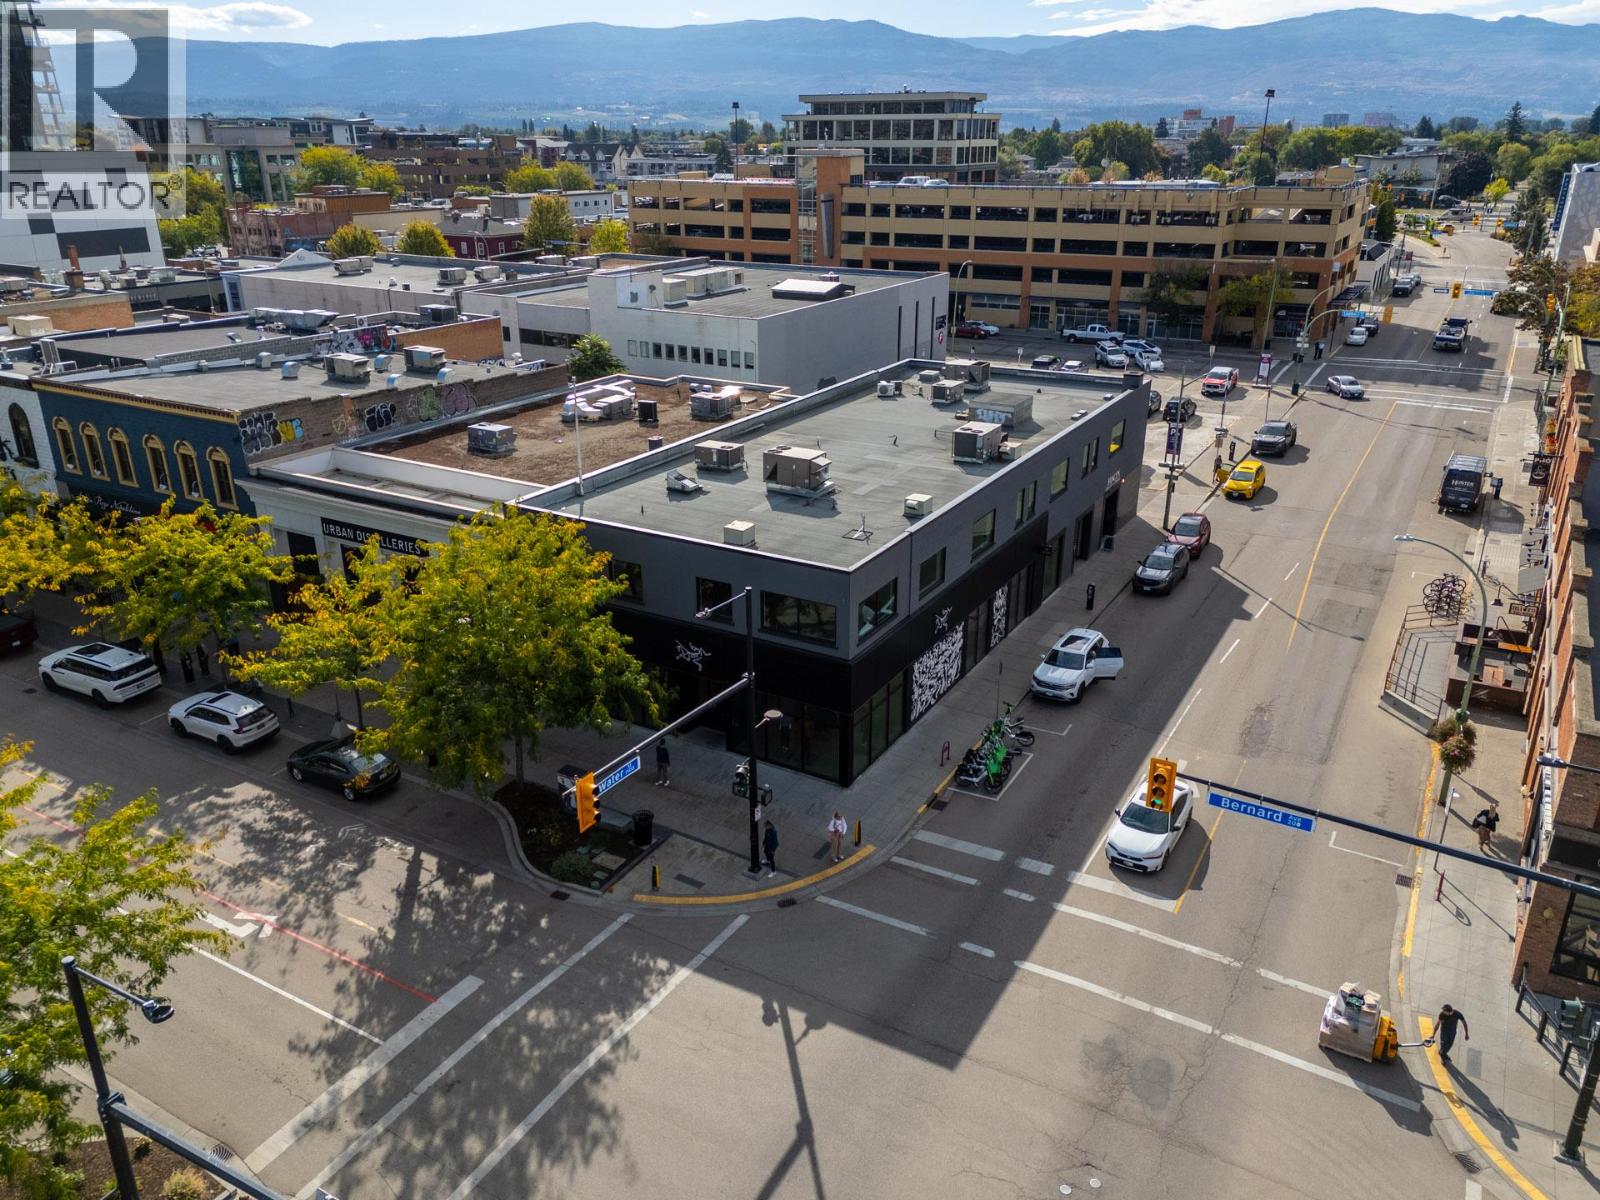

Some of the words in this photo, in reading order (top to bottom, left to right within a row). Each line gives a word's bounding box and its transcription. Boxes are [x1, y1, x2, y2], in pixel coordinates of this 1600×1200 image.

[323, 523, 354, 540] URBAN
[356, 530, 421, 555] DISLLERIES
[598, 770, 624, 792] Water
[1221, 797, 1282, 822] Bernard
